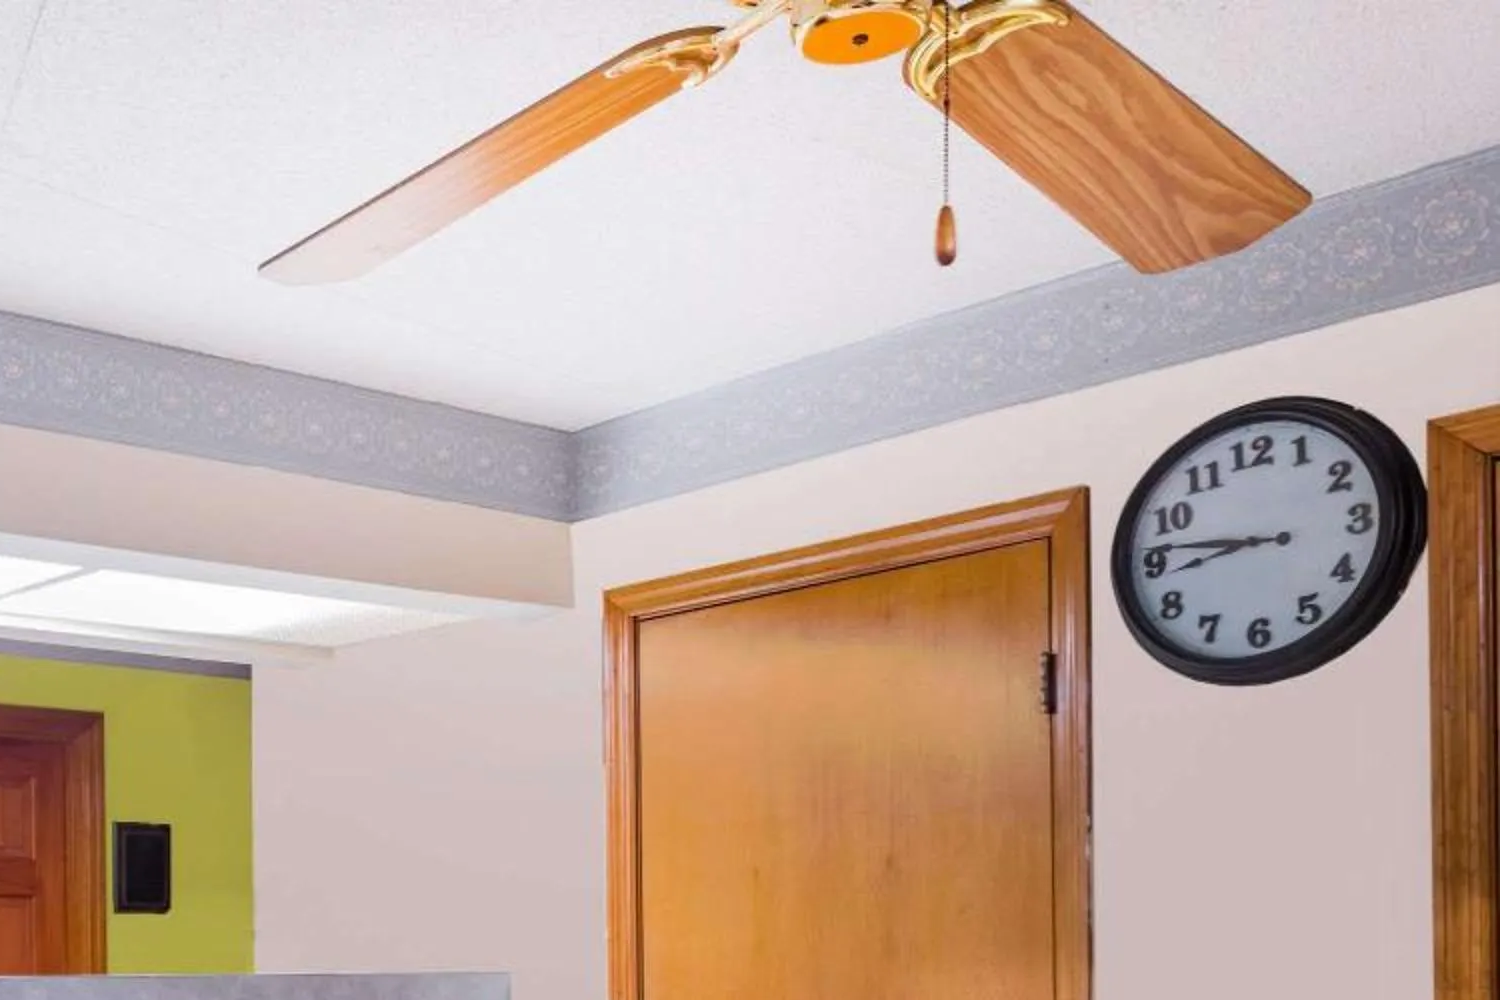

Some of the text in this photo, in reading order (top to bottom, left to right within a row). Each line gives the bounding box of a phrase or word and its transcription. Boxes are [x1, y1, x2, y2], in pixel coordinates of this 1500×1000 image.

[1229, 435, 1275, 473] 12
[1291, 435, 1312, 467] 1
[1184, 461, 1225, 495] 11
[1326, 460, 1352, 494] 2
[1153, 501, 1194, 536] 10
[1345, 502, 1373, 535] 3
[1143, 549, 1167, 579] 9
[1329, 552, 1356, 584] 4
[1160, 591, 1184, 620] 8
[1295, 592, 1323, 625] 5
[1198, 613, 1222, 644] 7
[1246, 618, 1272, 649] 6
